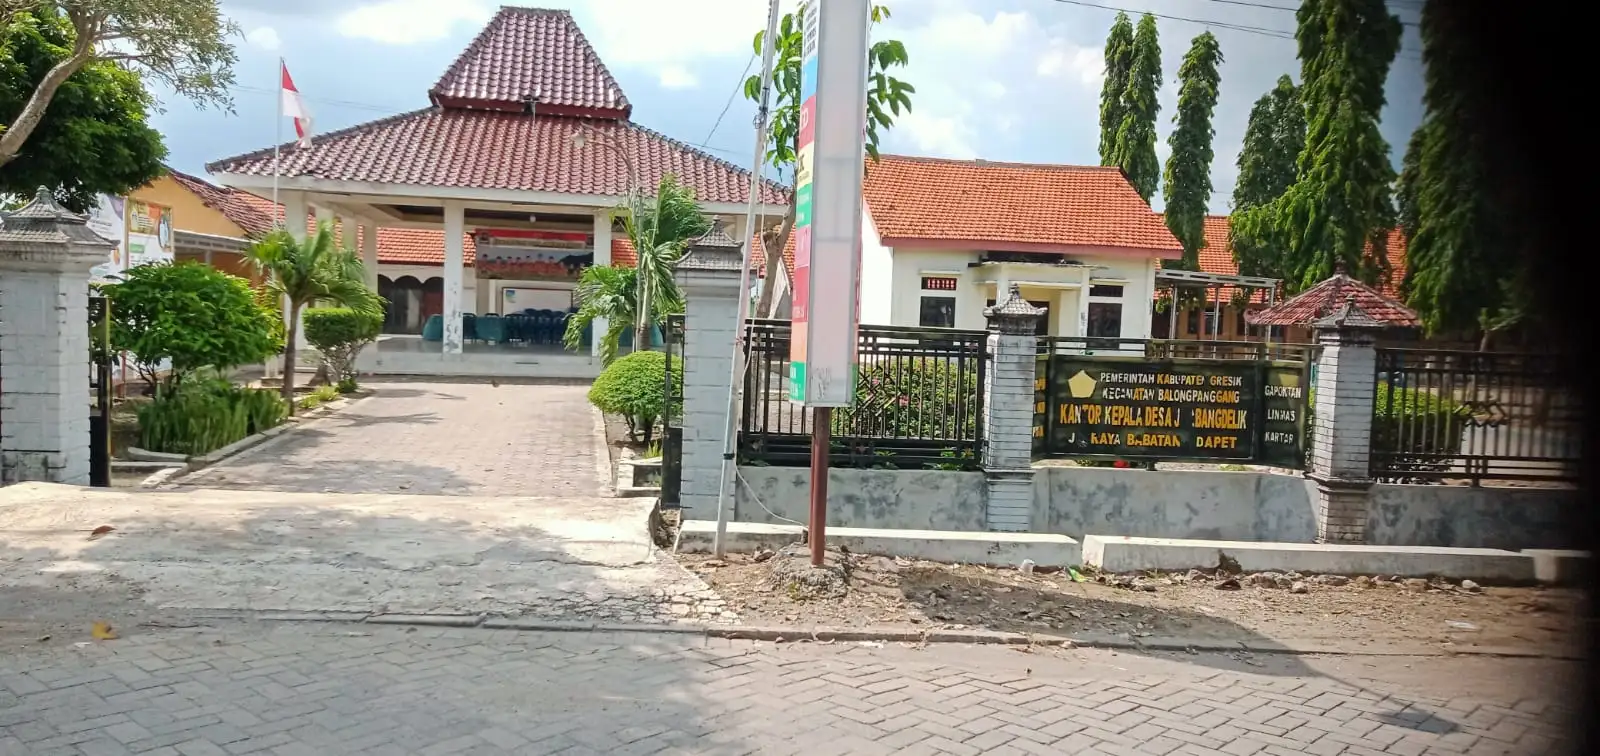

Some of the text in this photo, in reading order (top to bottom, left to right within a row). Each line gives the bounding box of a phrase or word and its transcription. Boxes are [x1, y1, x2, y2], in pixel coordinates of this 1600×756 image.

[1100, 372, 1155, 384] PEMERINTAH
[1210, 375, 1242, 387] GRESIK
[1158, 388, 1240, 404] BALONGPANGGANG
[1264, 385, 1302, 399] GAPOKTAN
[1104, 405, 1143, 426] KEPALA
[1145, 406, 1172, 427] DESA
[1267, 409, 1296, 422] LINMAS
[1091, 432, 1121, 445] RAYA
[1196, 436, 1238, 449] DAPET
